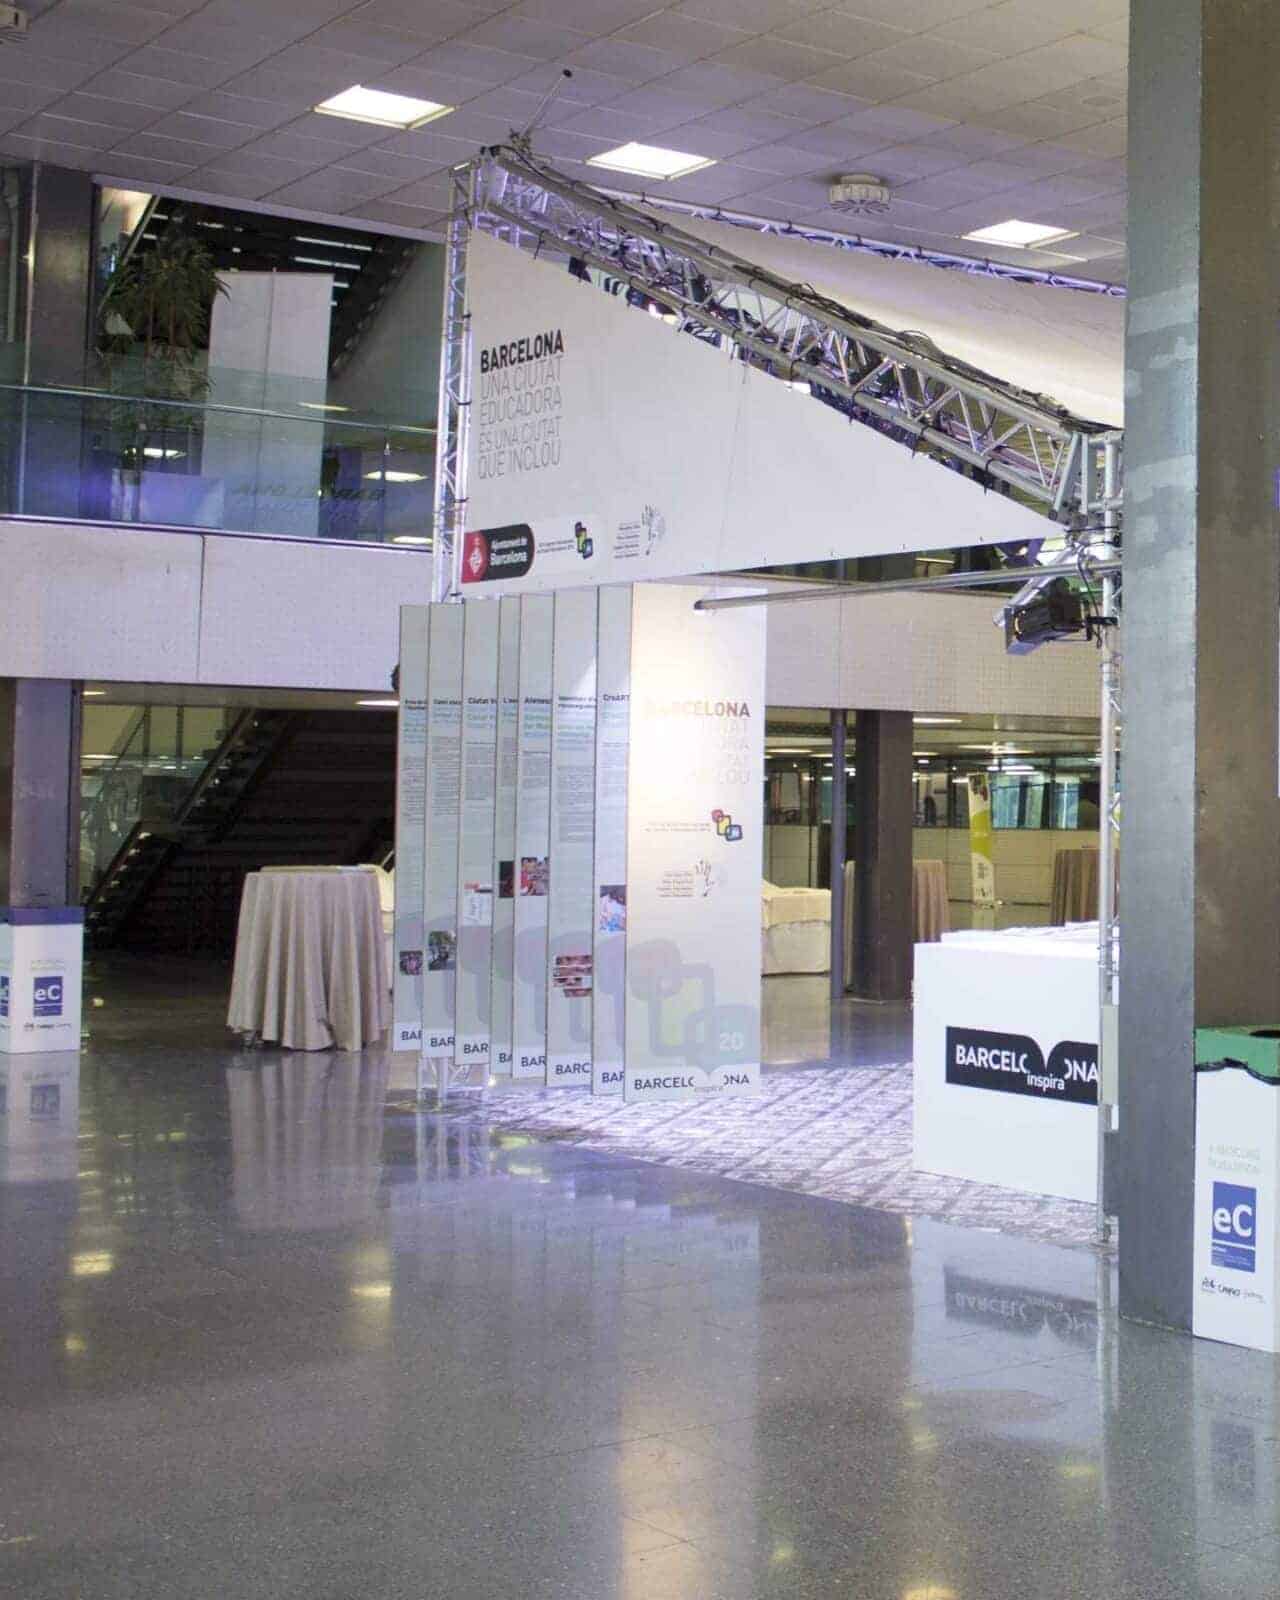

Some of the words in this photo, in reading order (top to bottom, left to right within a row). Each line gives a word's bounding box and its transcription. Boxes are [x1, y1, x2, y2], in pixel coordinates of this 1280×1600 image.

[480, 329, 564, 373] BARCELONA
[480, 368, 510, 400] UNA
[511, 355, 561, 393] CIUTAT
[480, 386, 561, 426] EDUCADORA
[479, 449, 505, 479] QUE
[507, 440, 562, 473] INCLOU
[35, 985, 60, 1001] eC
[720, 1032, 744, 1051] 20
[555, 1063, 592, 1075] BARC
[1027, 1073, 1065, 1091] inspira
[1213, 1204, 1252, 1237] eC
